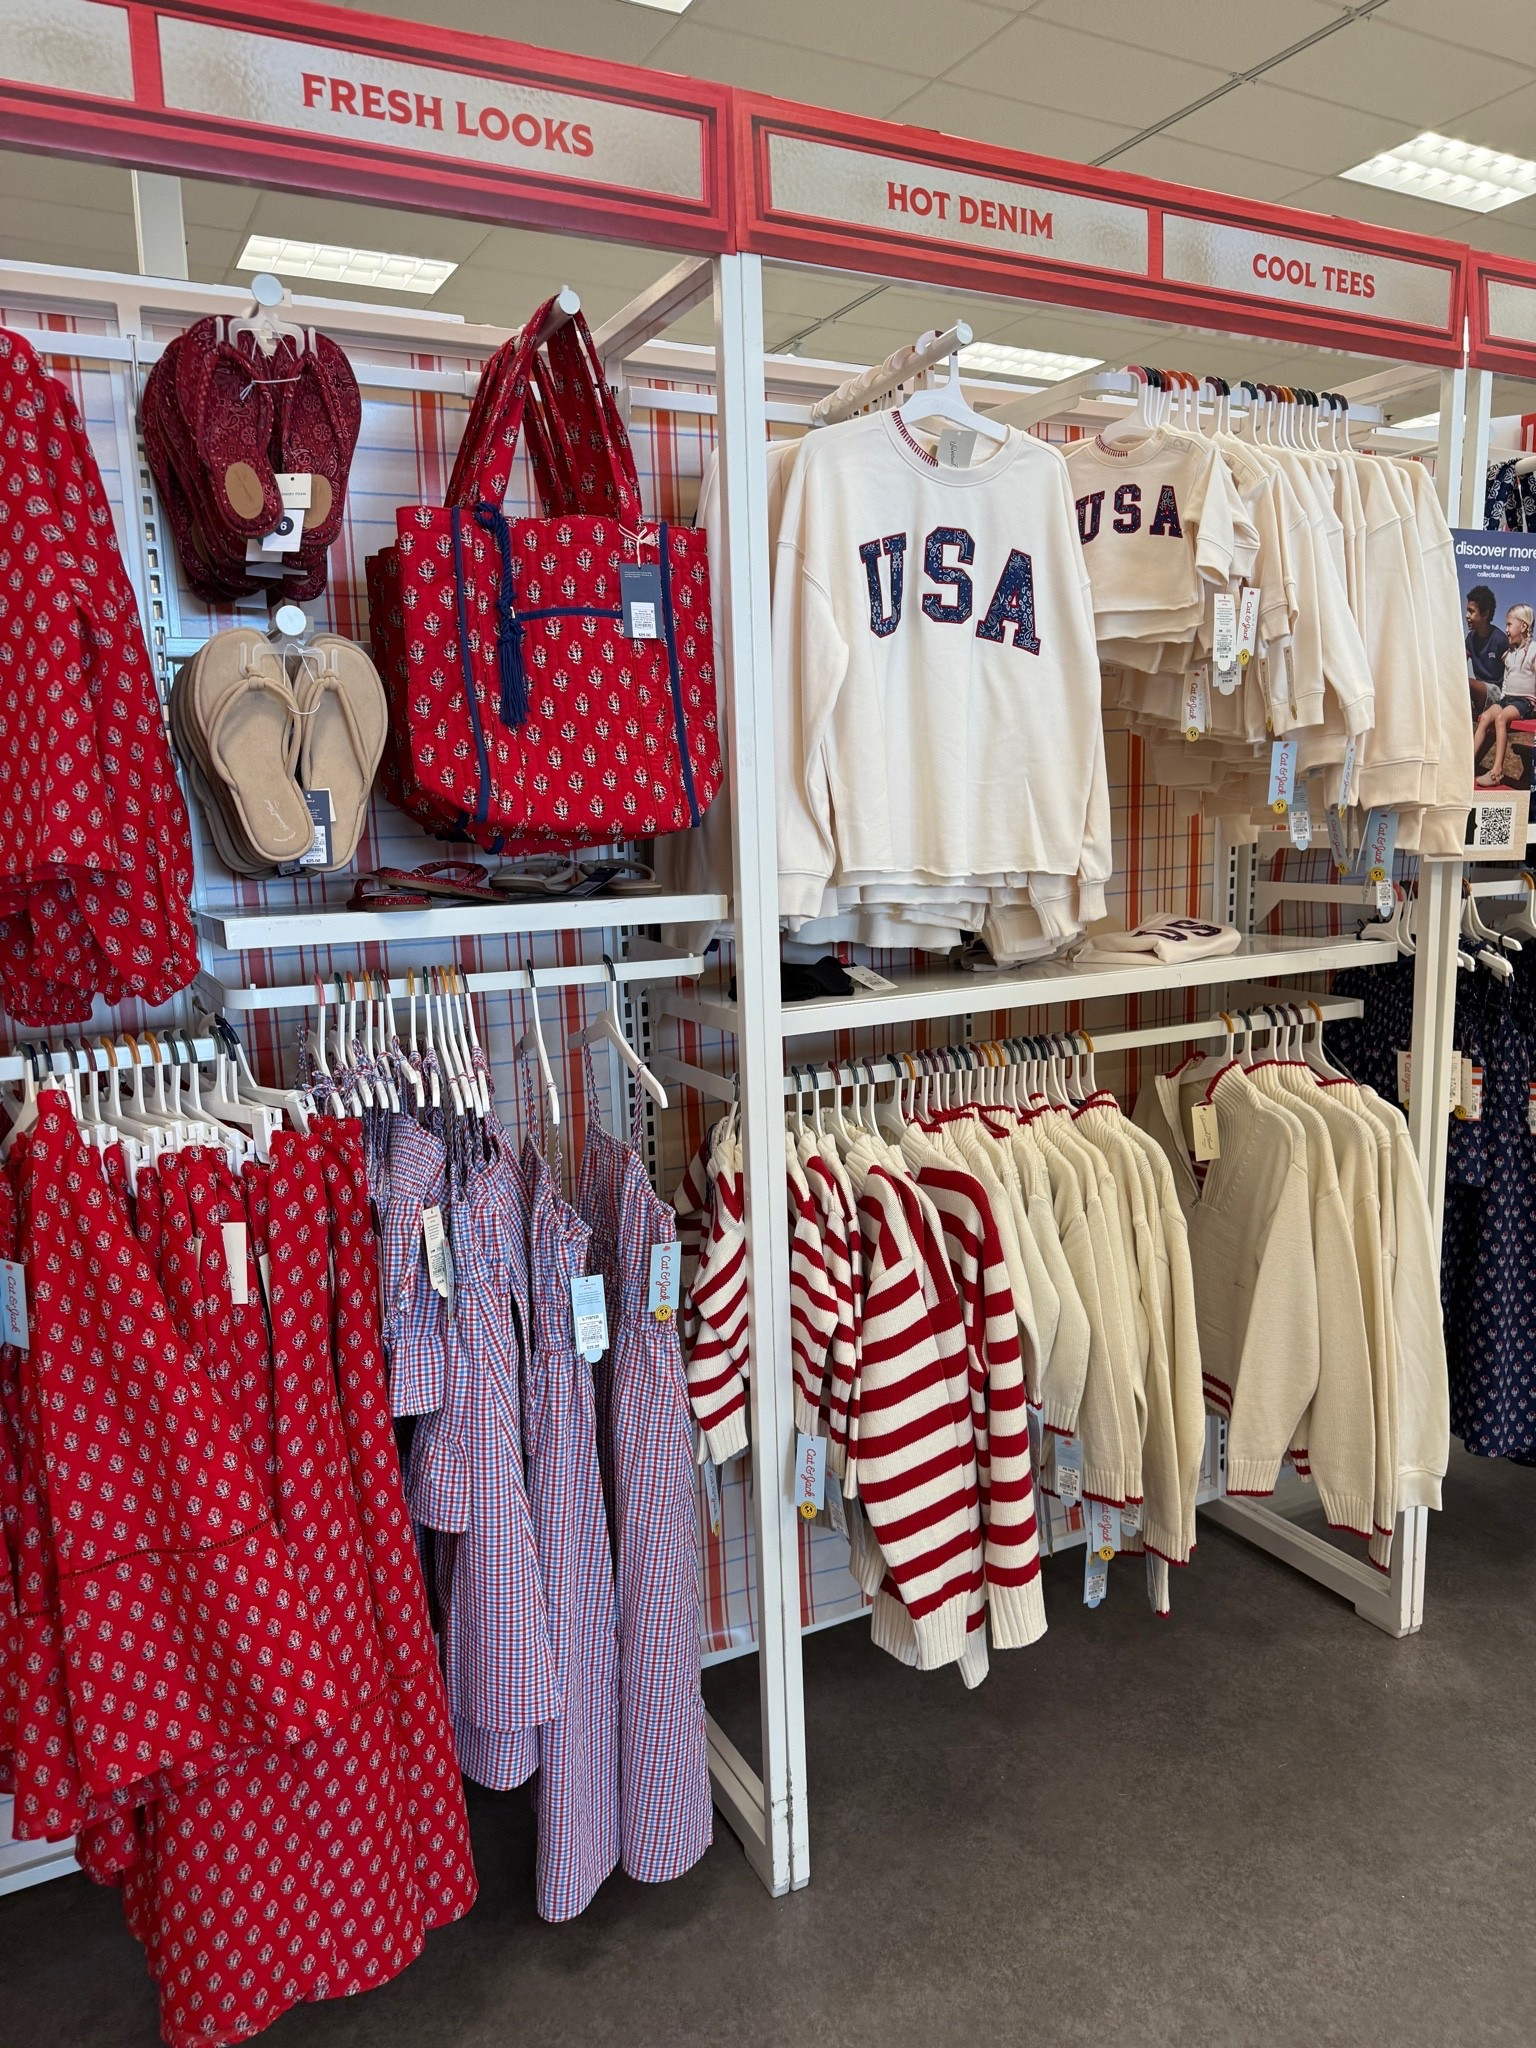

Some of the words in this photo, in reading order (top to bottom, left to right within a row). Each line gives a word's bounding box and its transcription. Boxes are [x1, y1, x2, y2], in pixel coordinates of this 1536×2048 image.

[301, 72, 444, 131] FRESH
[457, 101, 595, 157] LOOKS
[887, 181, 951, 220] HOT
[959, 195, 1054, 240] DENIM
[1252, 252, 1317, 290] COOL
[1322, 265, 1376, 299] TEES
[1075, 483, 1184, 546] USA
[280, 521, 288, 531] 6
[1455, 541, 1508, 558] discover
[858, 526, 1042, 656] USA
[1280, 752, 1288, 766] Cat
[1275, 776, 1287, 796] Jack
[1378, 822, 1388, 836] Cat
[1371, 844, 1386, 865] Jack
[660, 1255, 671, 1271] Cat
[7, 1276, 16, 1295] Cat
[655, 1280, 671, 1302] Jack
[6, 1304, 20, 1334] Jack
[806, 1448, 816, 1464] Cat
[800, 1473, 816, 1498] Jack
[1097, 1522, 1113, 1543] Jack
